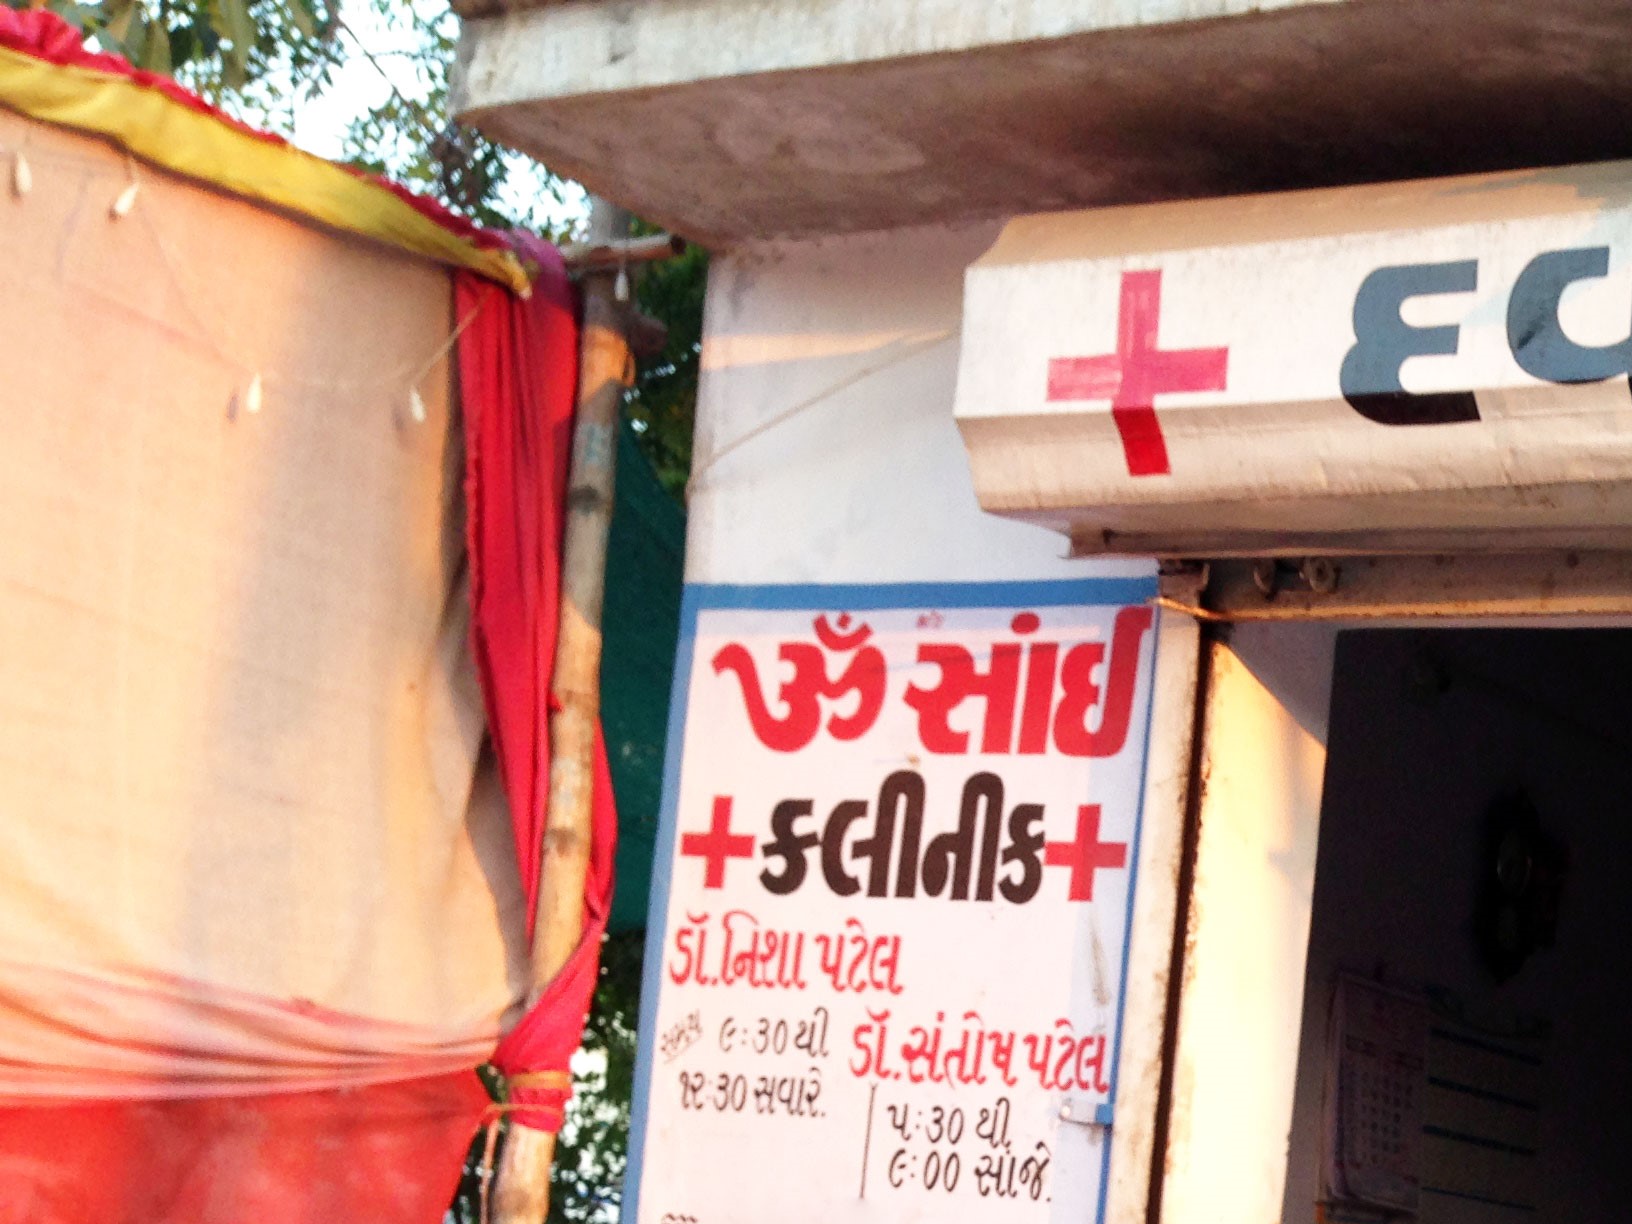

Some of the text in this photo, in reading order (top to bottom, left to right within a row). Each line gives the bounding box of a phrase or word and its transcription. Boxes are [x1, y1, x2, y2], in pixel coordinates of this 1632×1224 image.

[814, 917, 904, 995] પટેલ
[1022, 1018, 1110, 1093] પટેલ
[976, 1097, 1012, 1150] થી
